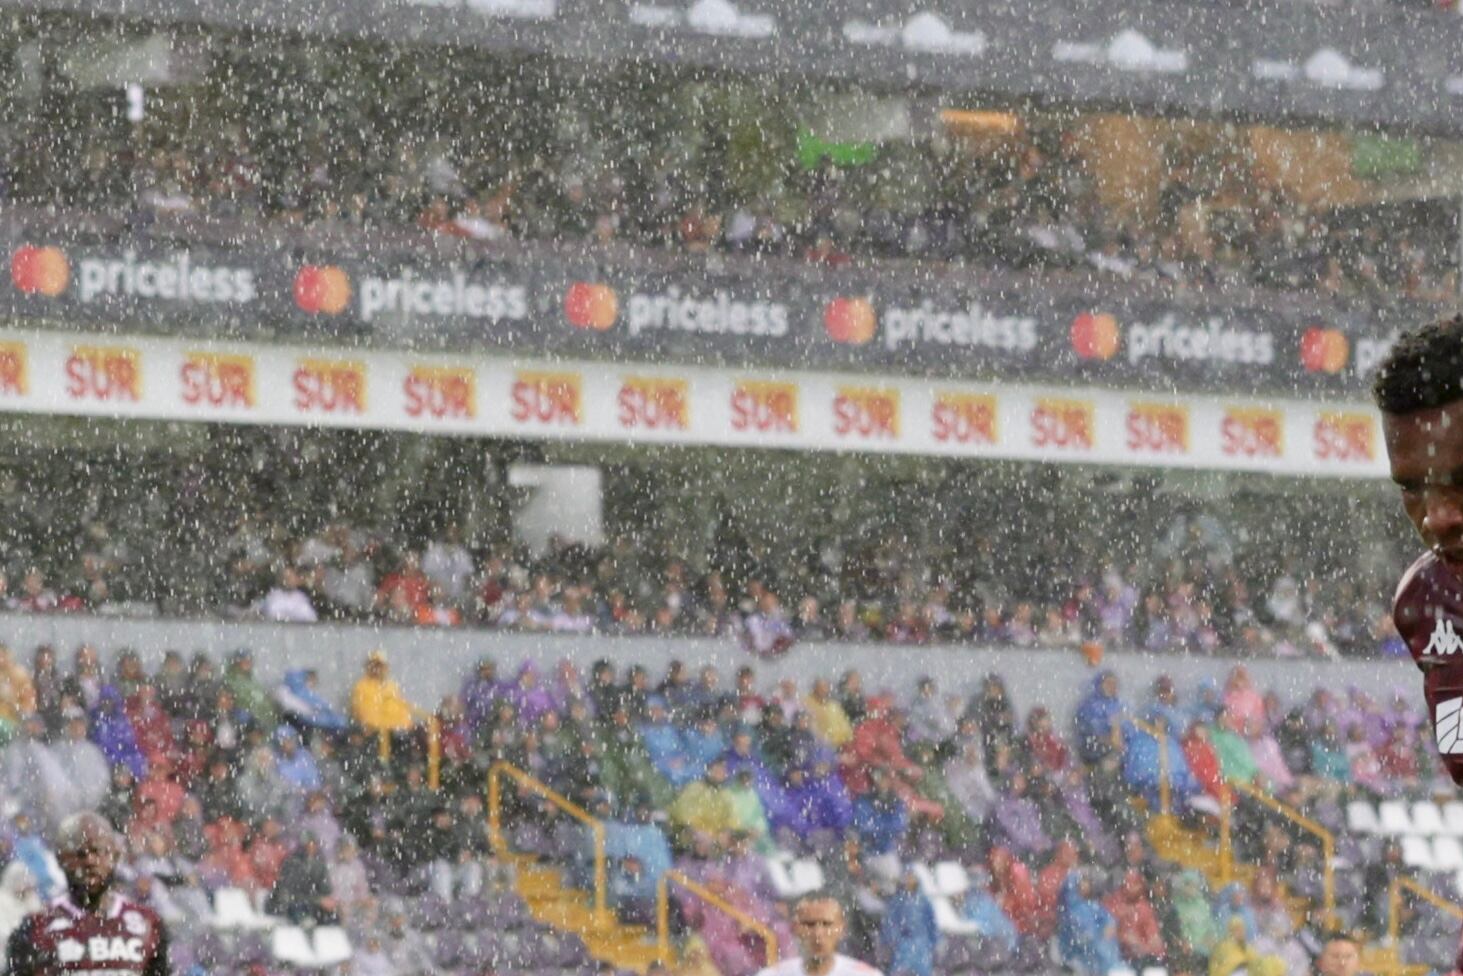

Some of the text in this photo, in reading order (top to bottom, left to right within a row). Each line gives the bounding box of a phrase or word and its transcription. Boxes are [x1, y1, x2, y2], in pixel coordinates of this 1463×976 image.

[80, 253, 255, 306] priceless
[362, 274, 524, 322] priceless
[630, 294, 788, 336] priceless
[886, 303, 1036, 352] priceless
[1128, 316, 1274, 364] priceless
[66, 354, 139, 403] SUR
[181, 360, 253, 408] SUR
[294, 364, 365, 412] SUR
[404, 373, 475, 419] SUR
[511, 378, 582, 424] SUR
[618, 384, 688, 430] SUR
[730, 387, 797, 433] SUR
[833, 395, 897, 438] SUR
[932, 400, 996, 444] SUR
[1030, 406, 1092, 449] SUR
[1126, 409, 1188, 453] SUR
[1221, 415, 1282, 457] SUR
[1312, 418, 1374, 461] SUR
[89, 936, 143, 961] BAC
